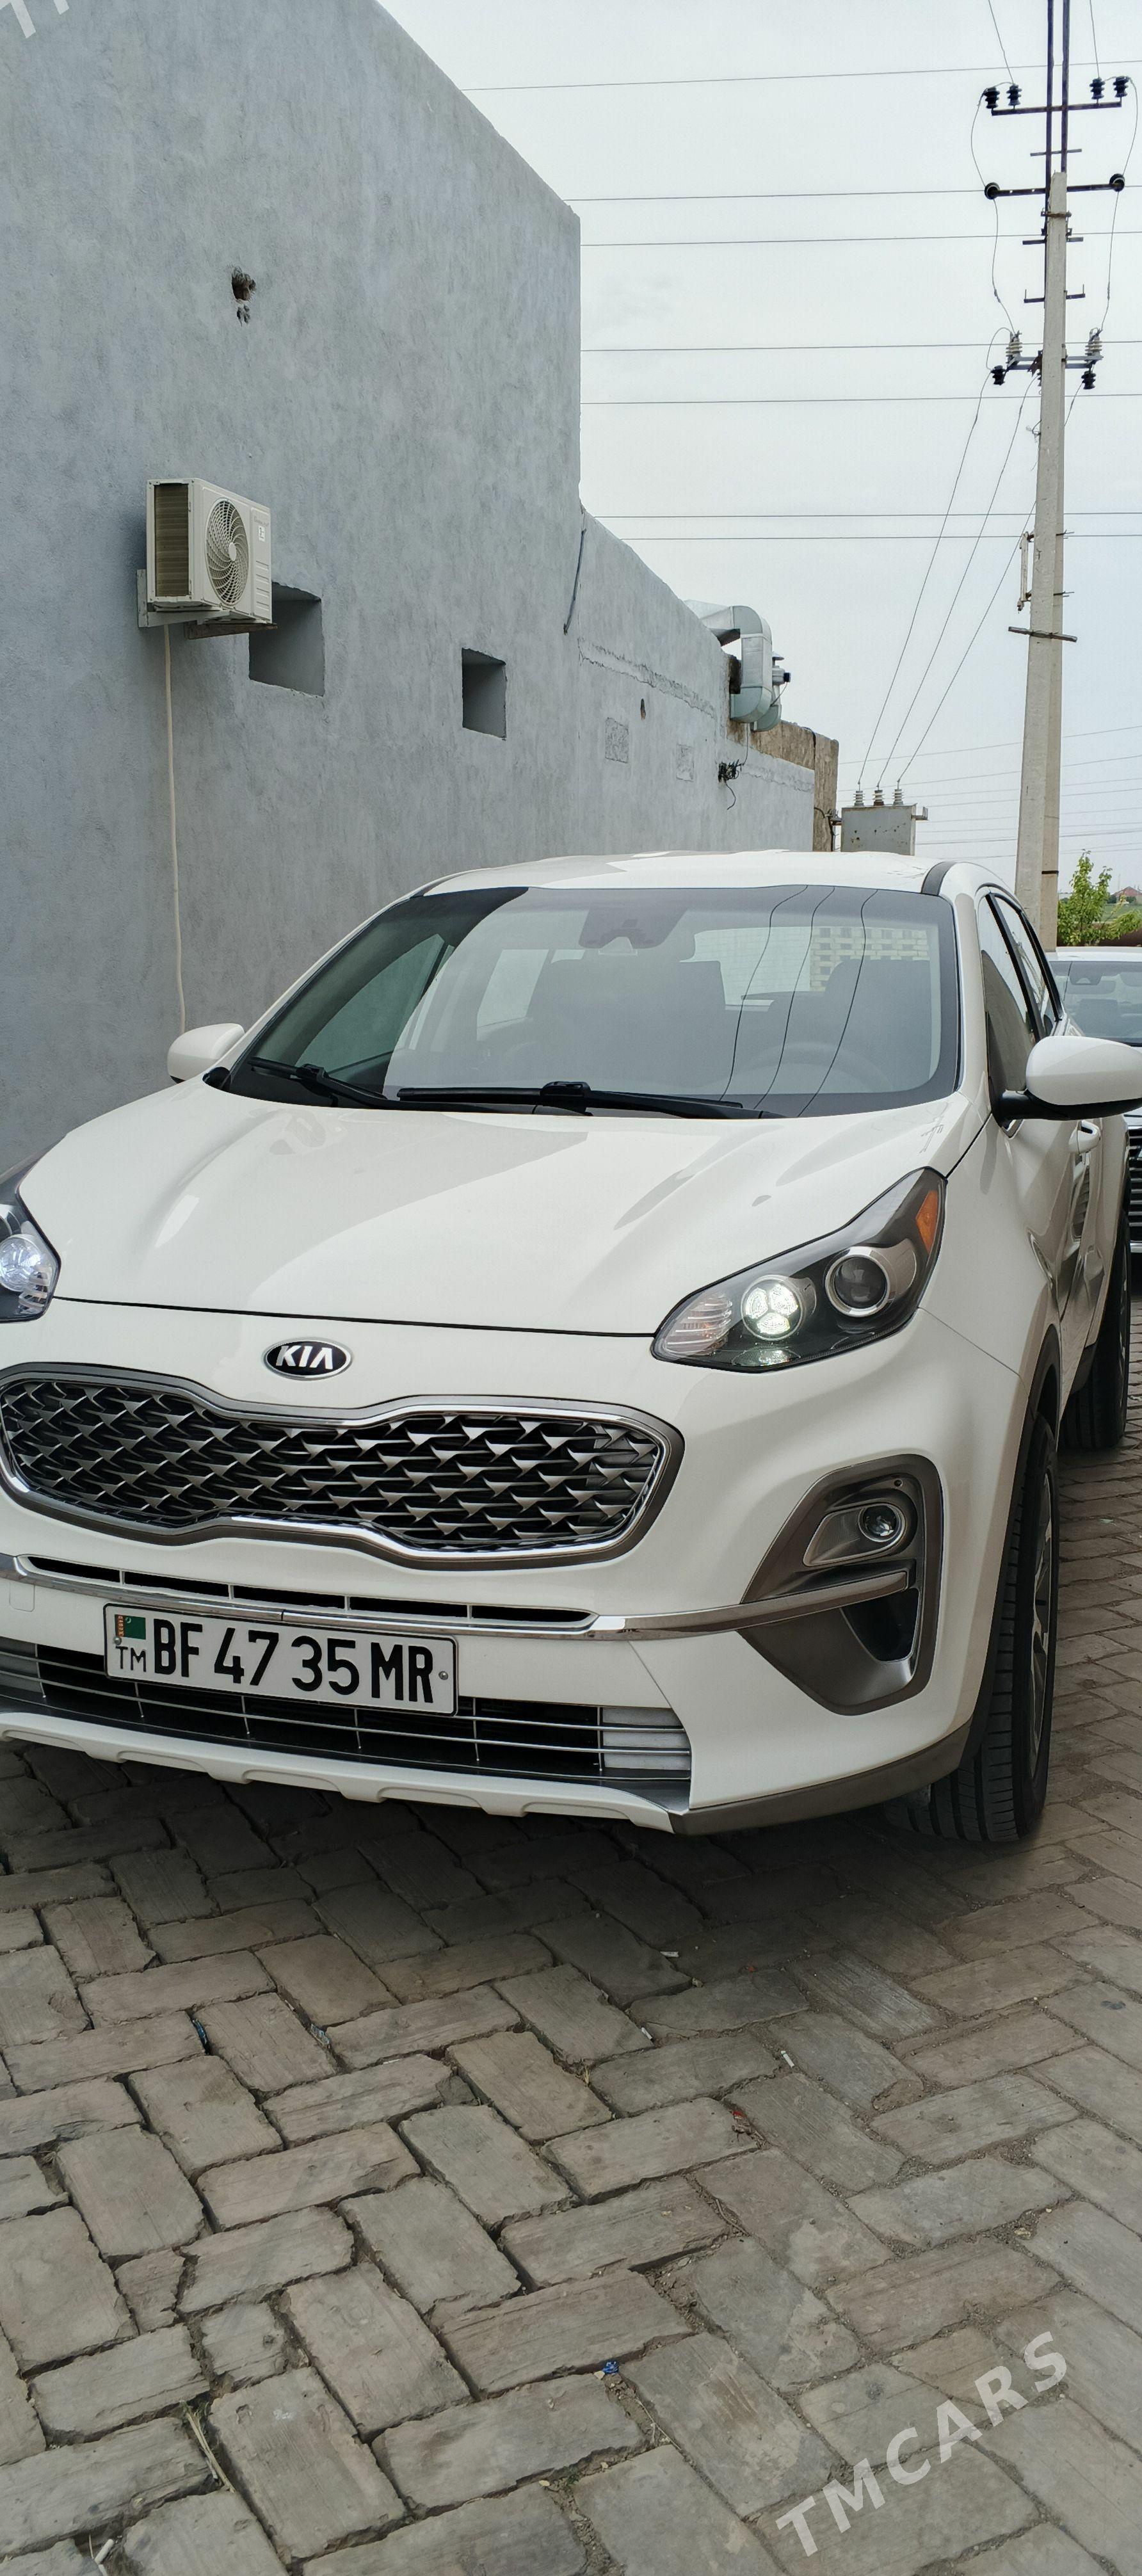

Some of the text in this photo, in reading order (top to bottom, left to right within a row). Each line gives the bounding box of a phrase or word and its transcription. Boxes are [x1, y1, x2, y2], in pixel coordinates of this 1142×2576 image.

[276, 1345, 333, 1370] KIA
[115, 1618, 433, 1703] TM BF 47 35 MR
